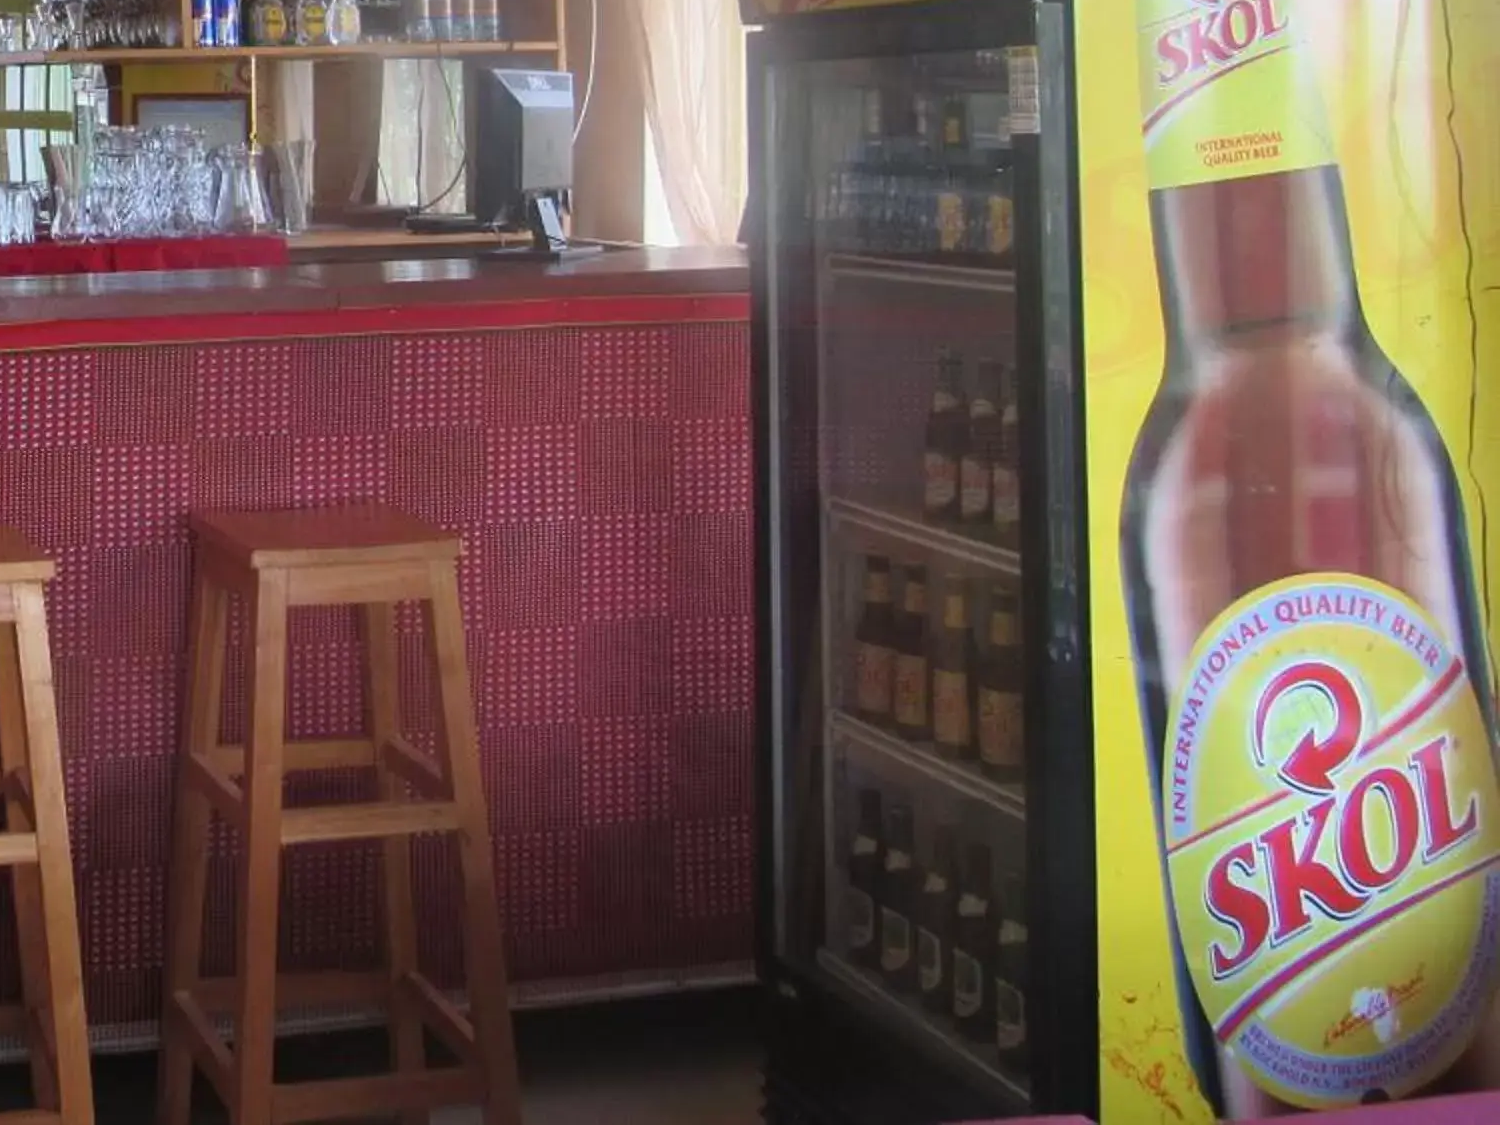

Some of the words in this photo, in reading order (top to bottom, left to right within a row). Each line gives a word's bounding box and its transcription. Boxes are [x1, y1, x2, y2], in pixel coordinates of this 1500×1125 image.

[1195, 130, 1284, 153] INTERNATIONAL
[1203, 149, 1251, 167] QUALITY
[1253, 145, 1280, 160] BEER
[1173, 612, 1269, 823] INTERNATIONAL
[1274, 593, 1387, 624] QUALITY
[1391, 614, 1439, 667] BEER
[1205, 736, 1479, 980] SKOL
